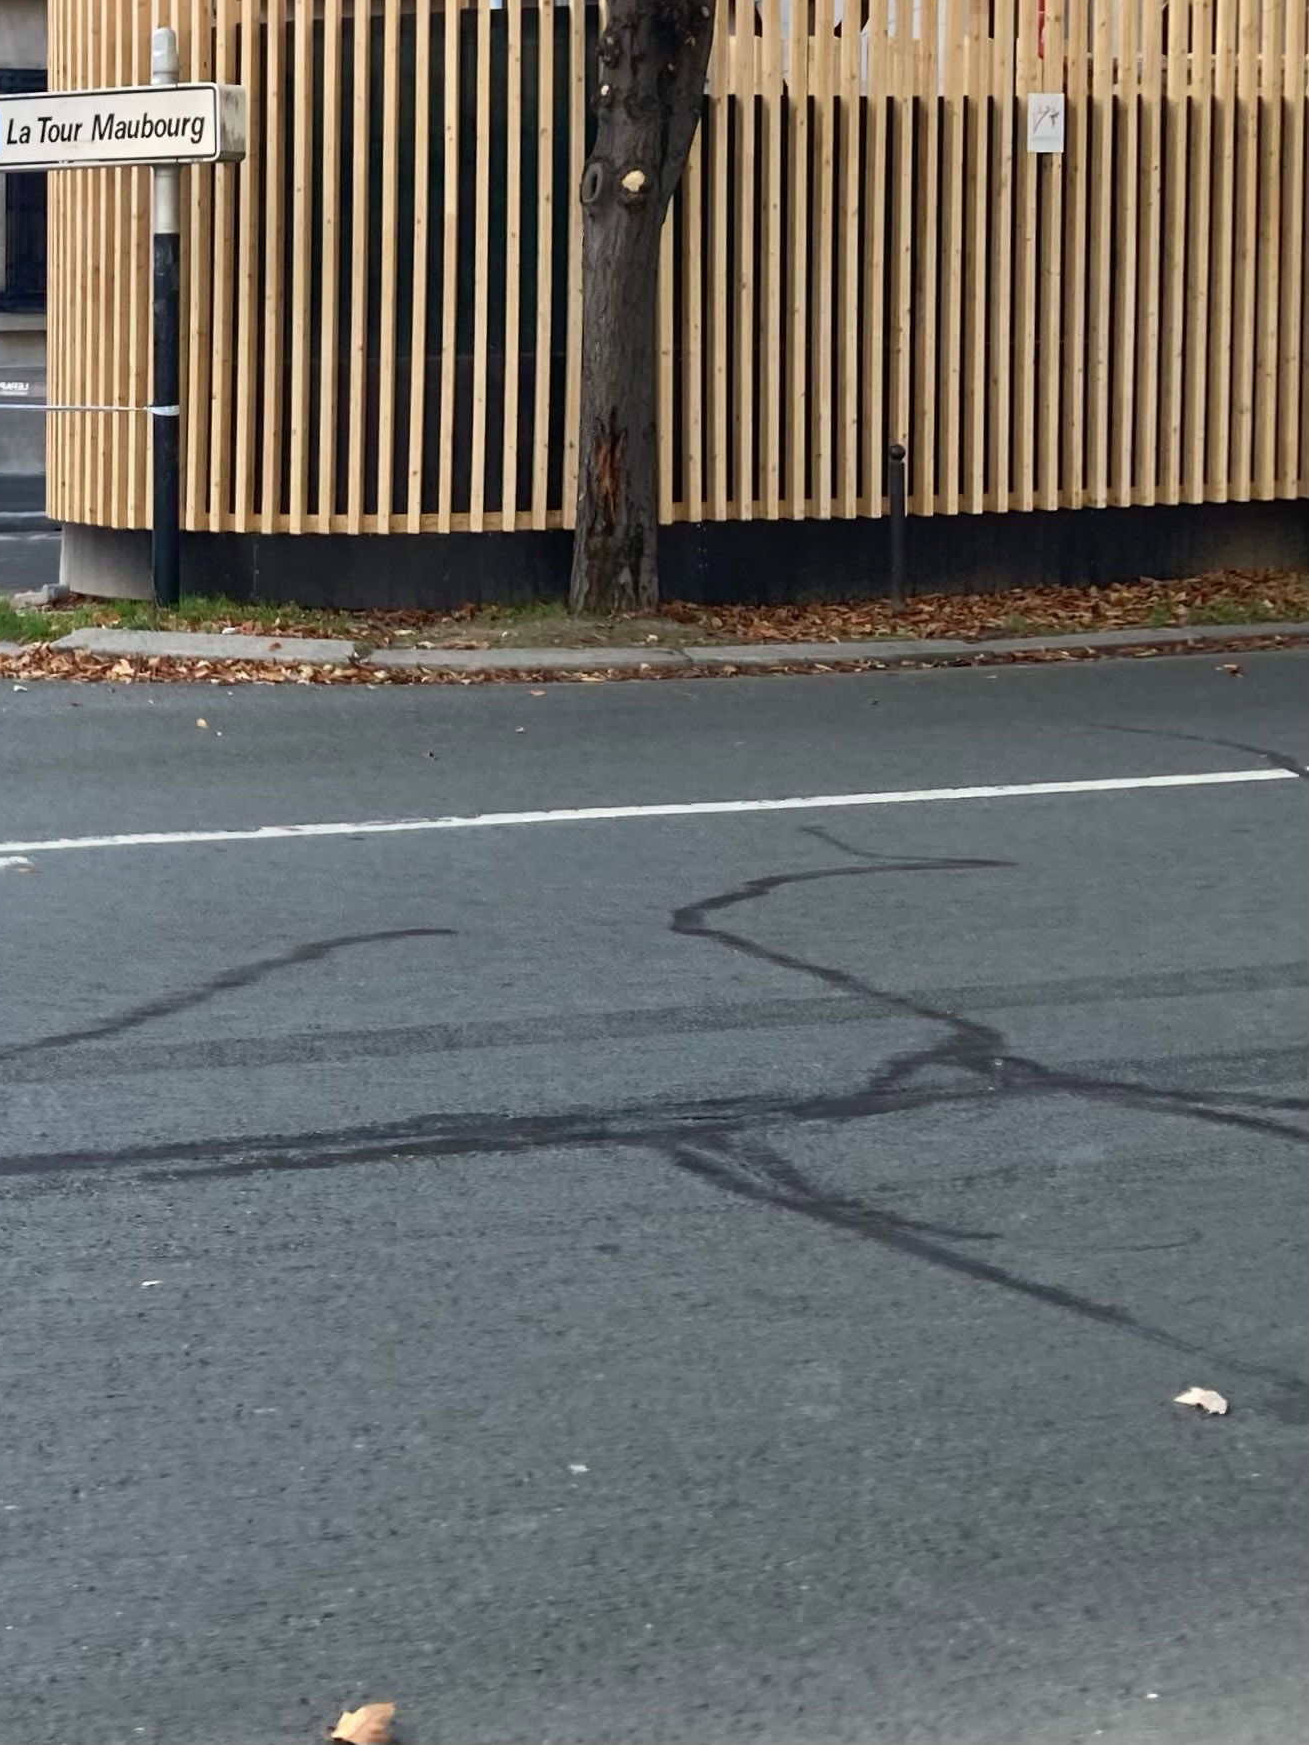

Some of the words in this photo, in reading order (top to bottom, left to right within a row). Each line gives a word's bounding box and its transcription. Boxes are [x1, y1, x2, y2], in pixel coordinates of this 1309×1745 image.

[6, 118, 31, 145] La
[37, 116, 83, 143] Tour
[91, 112, 205, 144] Maubourg
